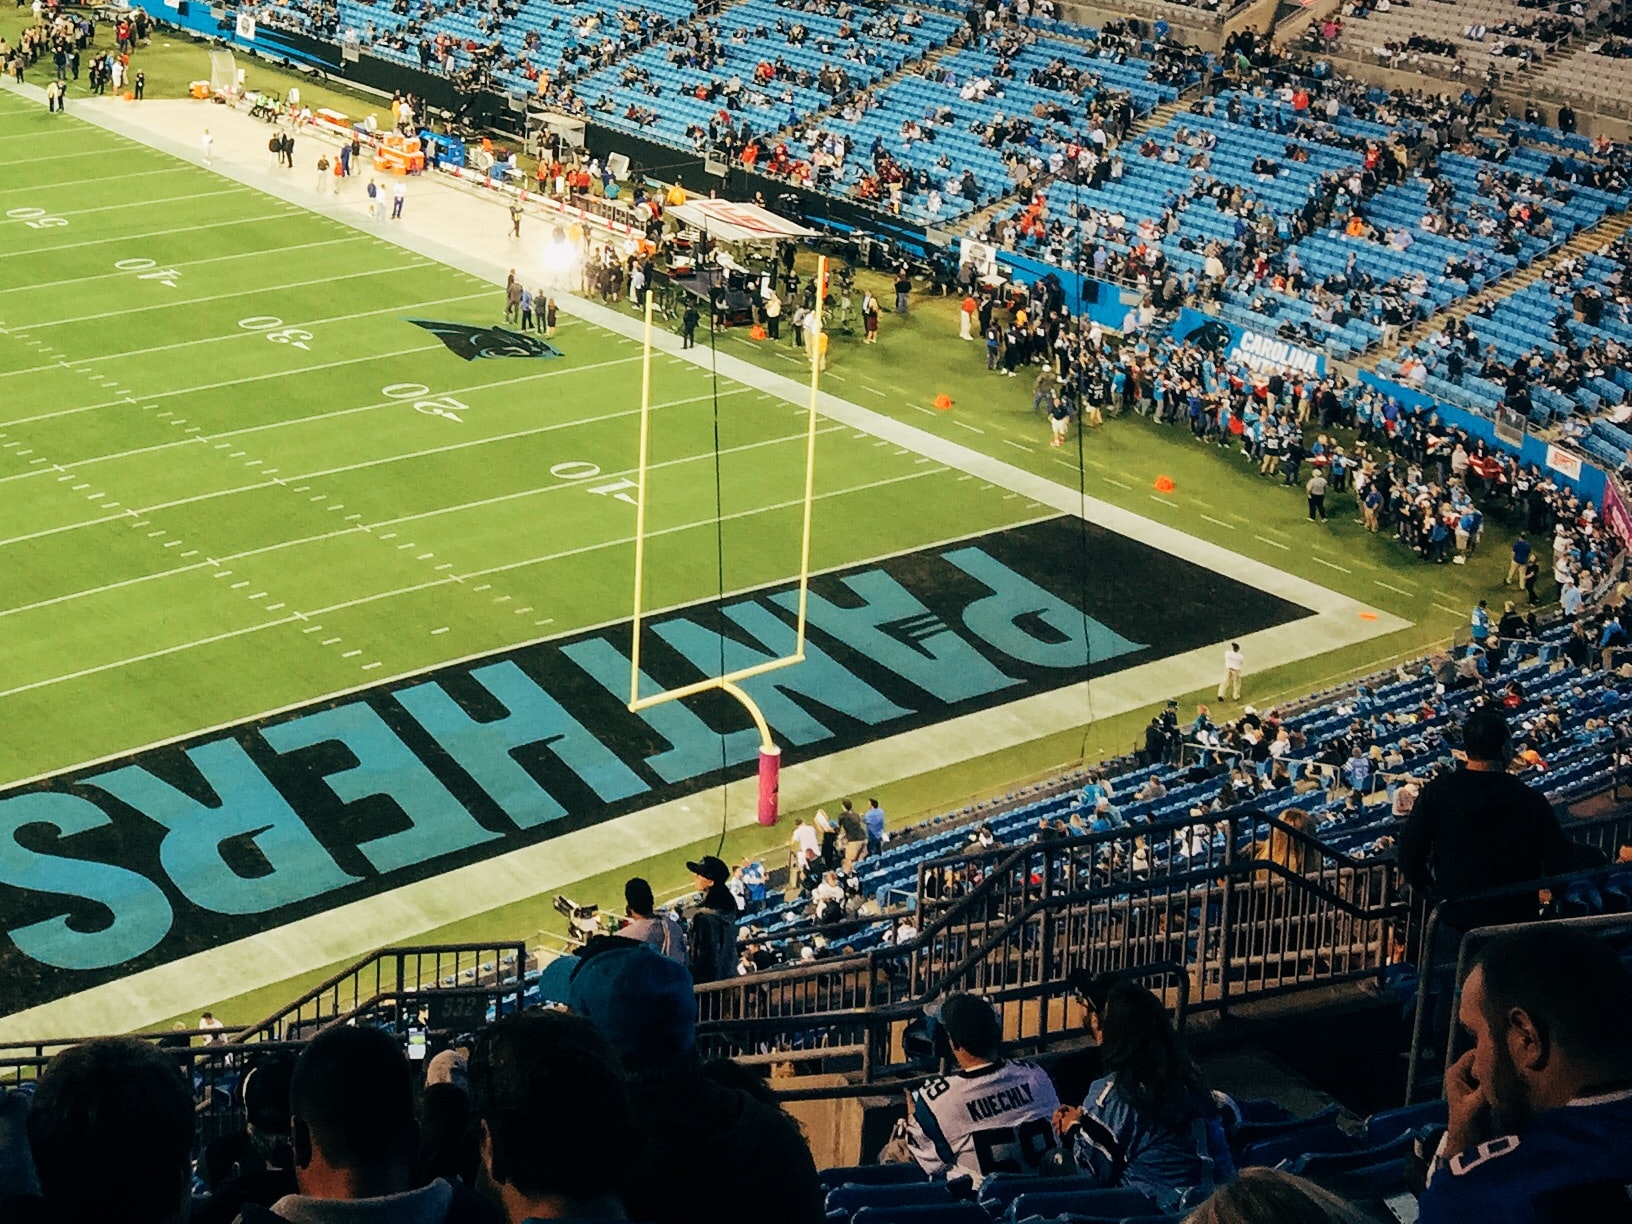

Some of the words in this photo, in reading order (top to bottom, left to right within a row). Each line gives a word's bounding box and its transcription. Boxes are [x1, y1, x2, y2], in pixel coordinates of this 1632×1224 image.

[6, 207, 69, 230] 50
[238, 315, 314, 345] 30
[1240, 330, 1318, 375] CAROLINA
[381, 382, 469, 416] 20
[549, 461, 639, 496] 10
[966, 1082, 1035, 1123] KUECHLY
